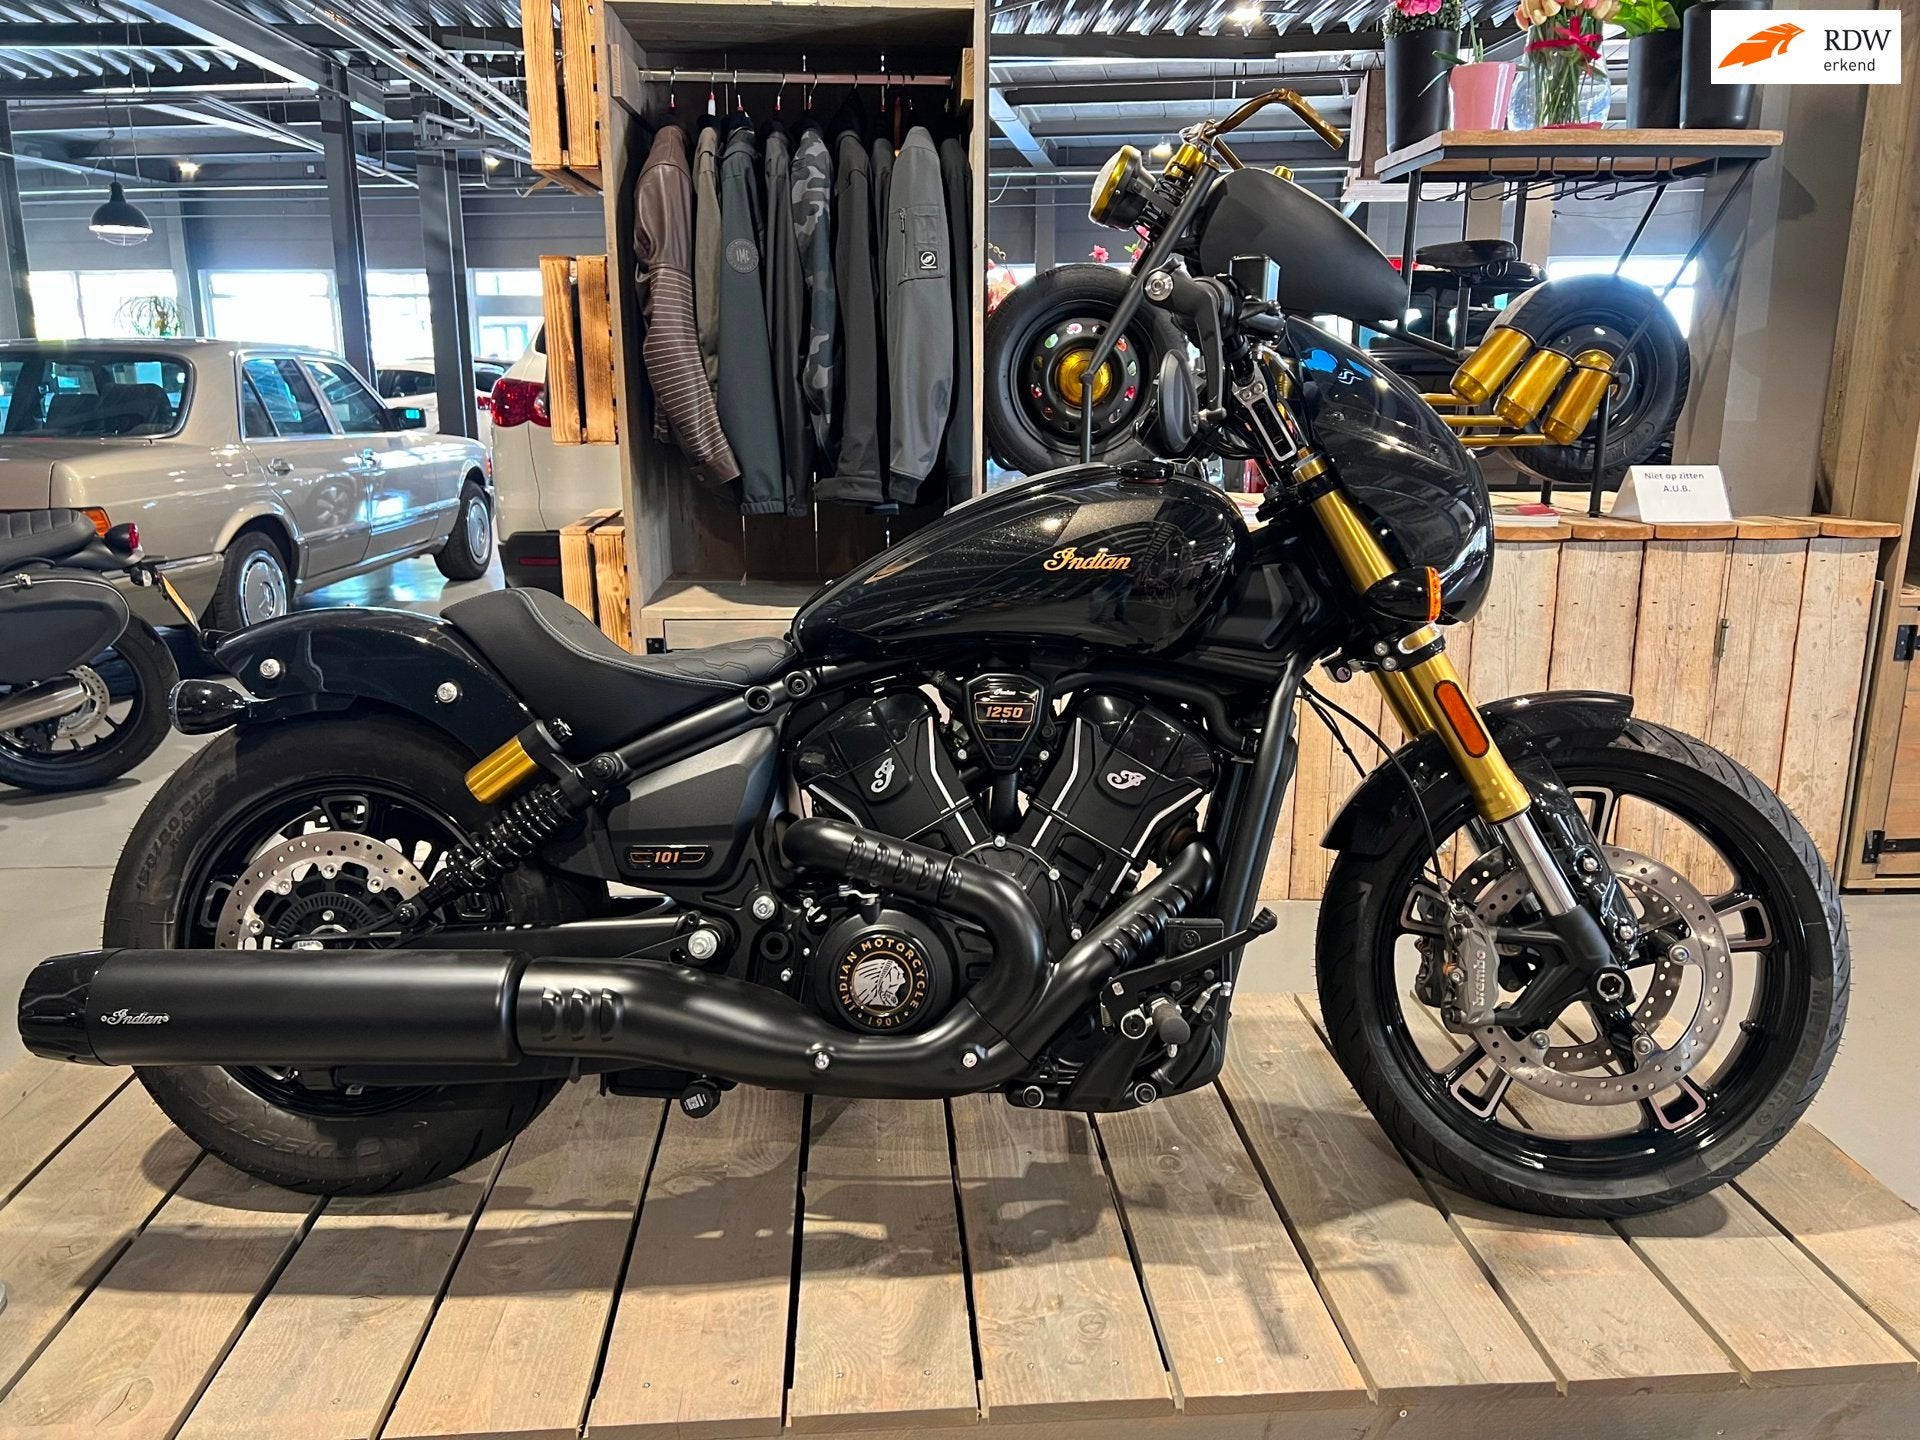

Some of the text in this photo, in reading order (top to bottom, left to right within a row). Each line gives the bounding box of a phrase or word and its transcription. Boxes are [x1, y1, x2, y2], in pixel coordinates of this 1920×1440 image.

[1644, 472, 1663, 480] Niet
[1679, 472, 1705, 480] zitten
[1043, 547, 1132, 571] Indian
[986, 705, 1024, 718] 1250
[654, 851, 680, 863] 101
[839, 938, 926, 1012] INDIAN MOTORCYCLE
[1472, 950, 1486, 1006] brembo
[106, 1008, 163, 1025] Indian
[868, 1015, 900, 1026] 1901
